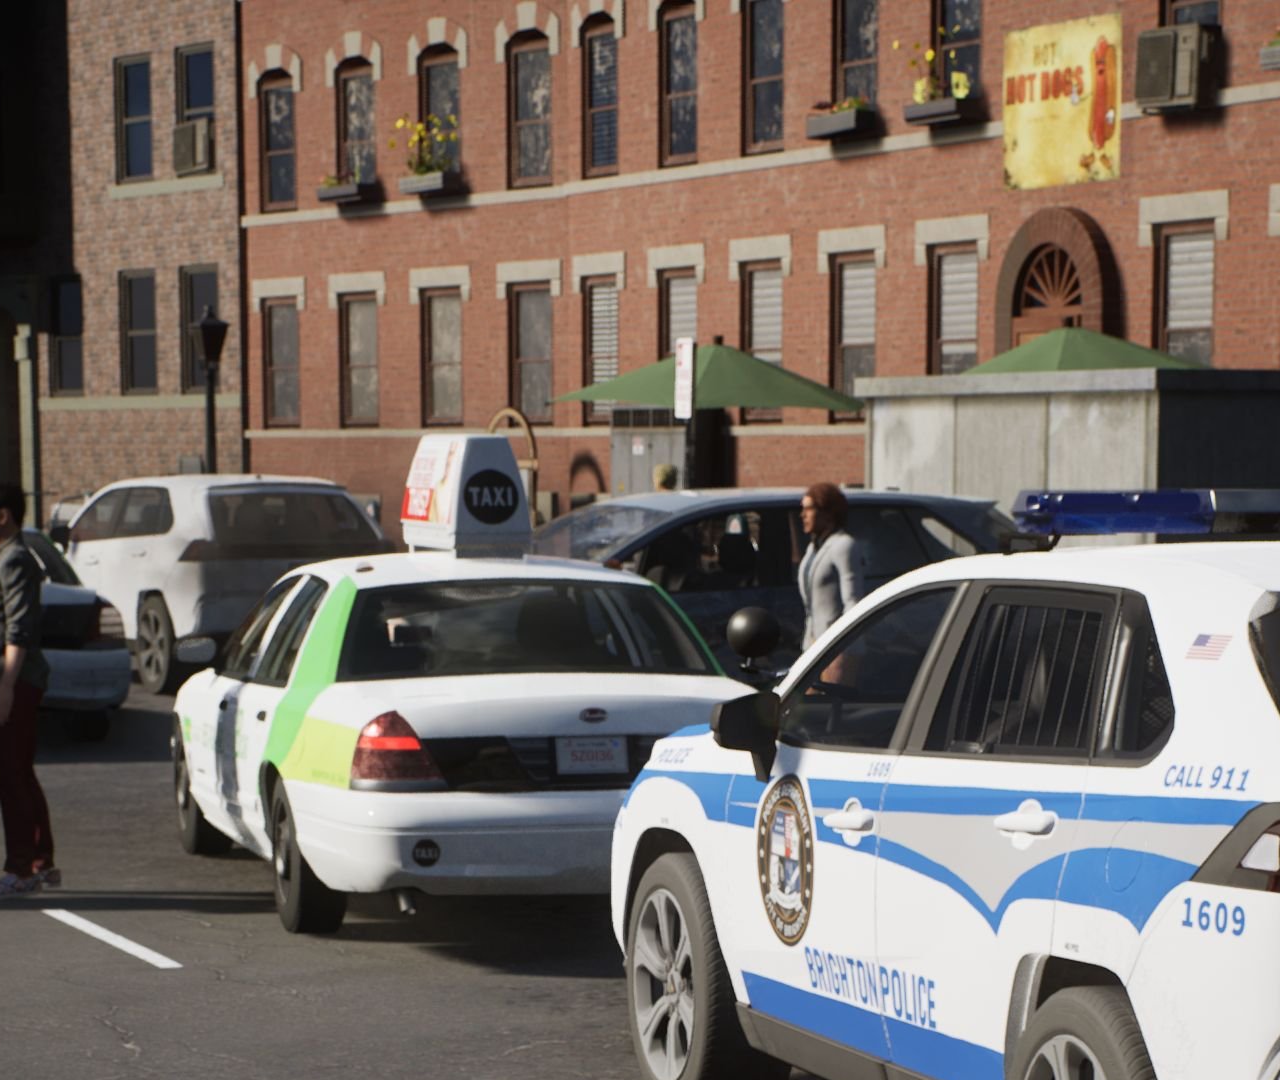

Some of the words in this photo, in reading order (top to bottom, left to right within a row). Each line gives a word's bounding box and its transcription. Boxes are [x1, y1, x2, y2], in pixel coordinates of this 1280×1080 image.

[1006, 73, 1036, 106] HOT
[1040, 66, 1084, 101] DOGS
[468, 485, 513, 507] TAXI
[1163, 765, 1204, 788] CALL
[1209, 765, 1250, 792] 911
[1181, 897, 1246, 937] 1609
[804, 945, 879, 1009] BRIGHTON
[879, 965, 936, 1029] POLICE
